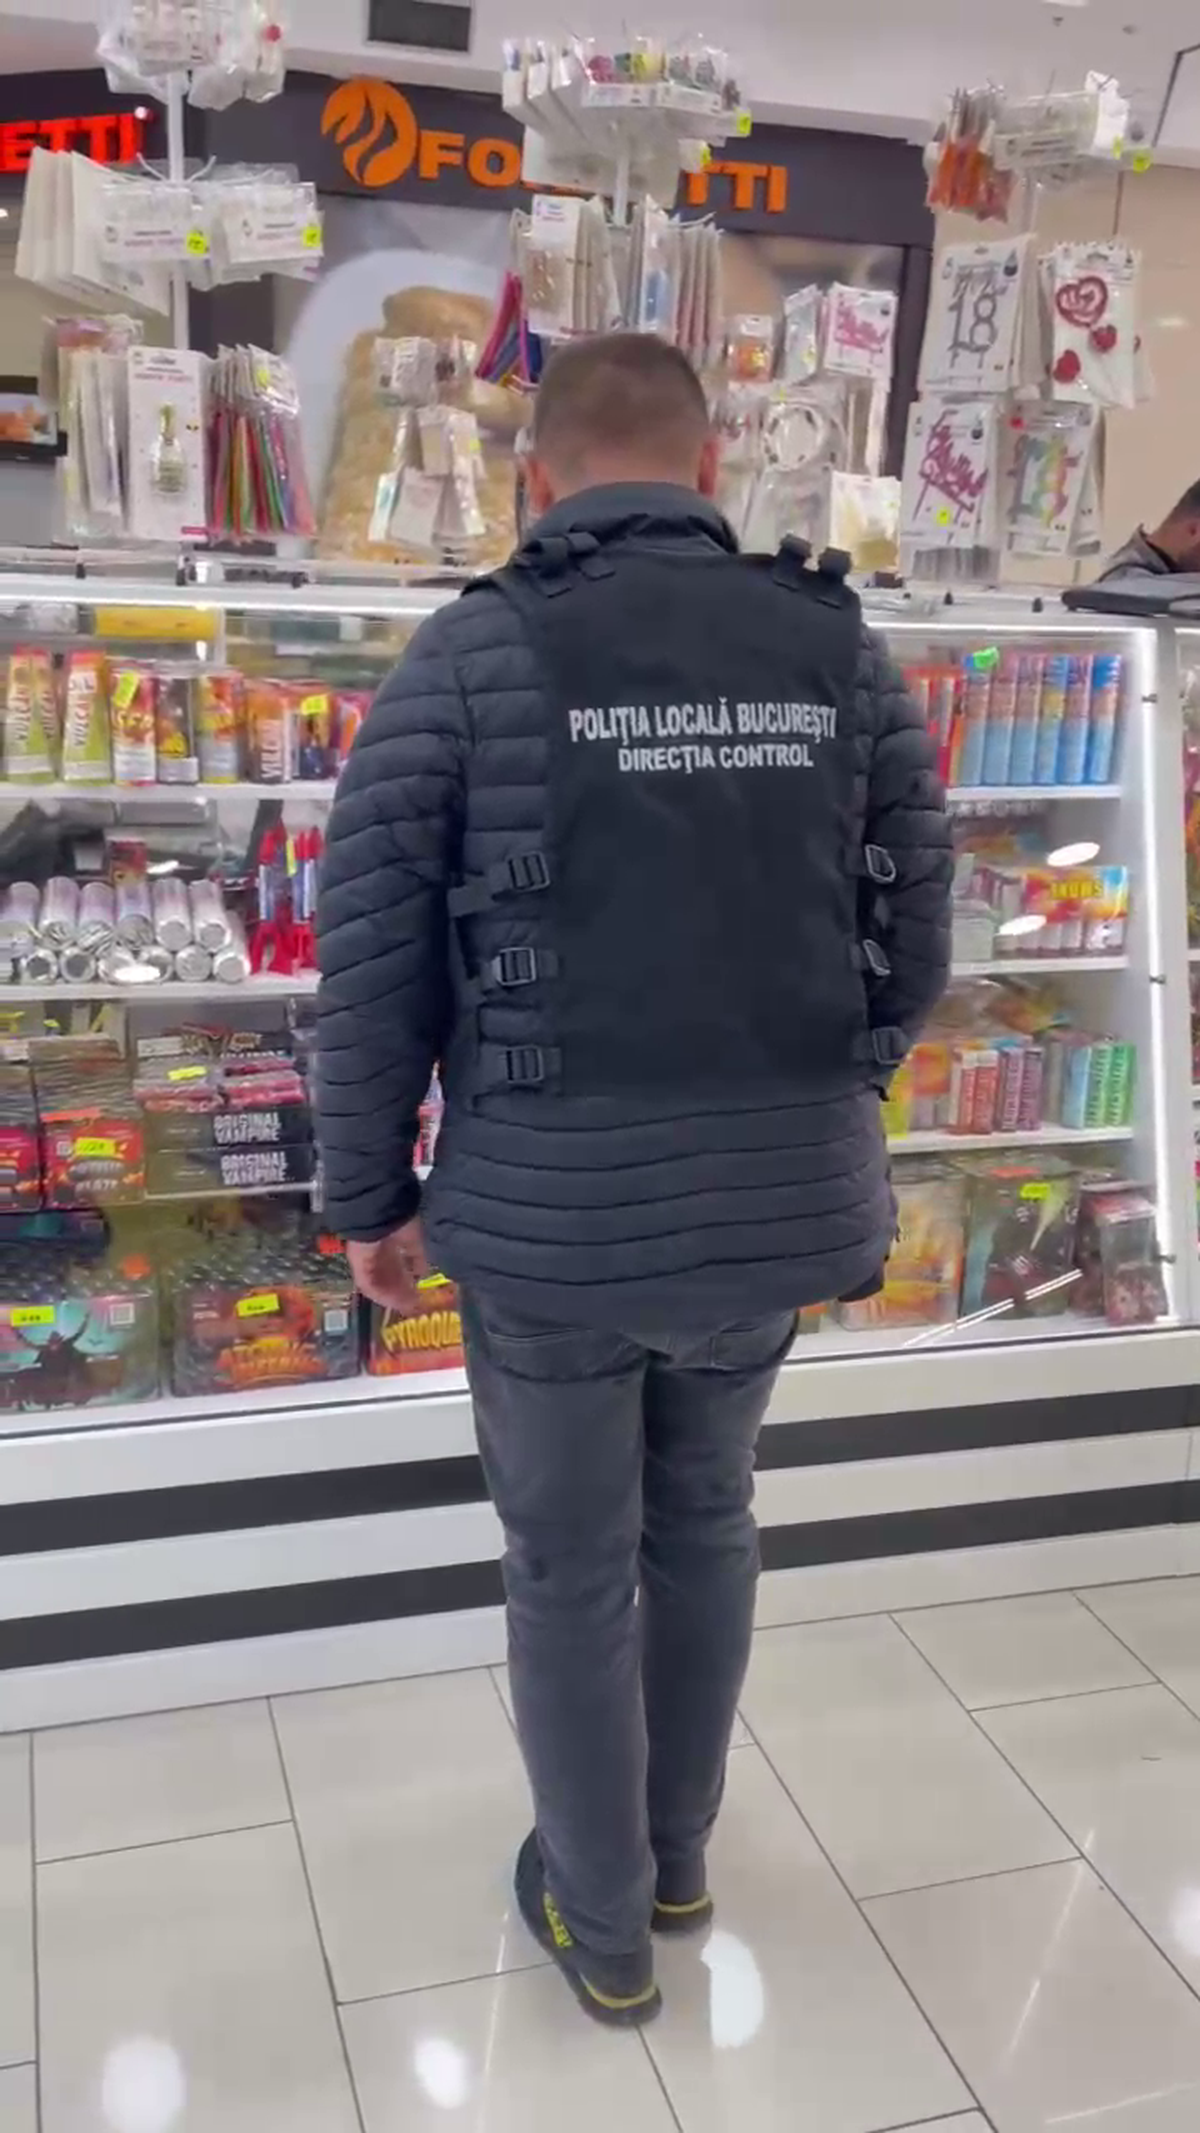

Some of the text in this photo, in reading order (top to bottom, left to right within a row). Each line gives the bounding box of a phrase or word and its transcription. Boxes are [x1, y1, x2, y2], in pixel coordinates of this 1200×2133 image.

[419, 128, 788, 213] FOTTI
[654, 696, 733, 738] LOCALĂ
[719, 744, 815, 769] CONTROL
[214, 1112, 280, 1128] ORIGINAL
[214, 1124, 282, 1144] VAMPIRE
[221, 1151, 286, 1168] ORIGINAL
[221, 1163, 287, 1185] VAMPIRE
